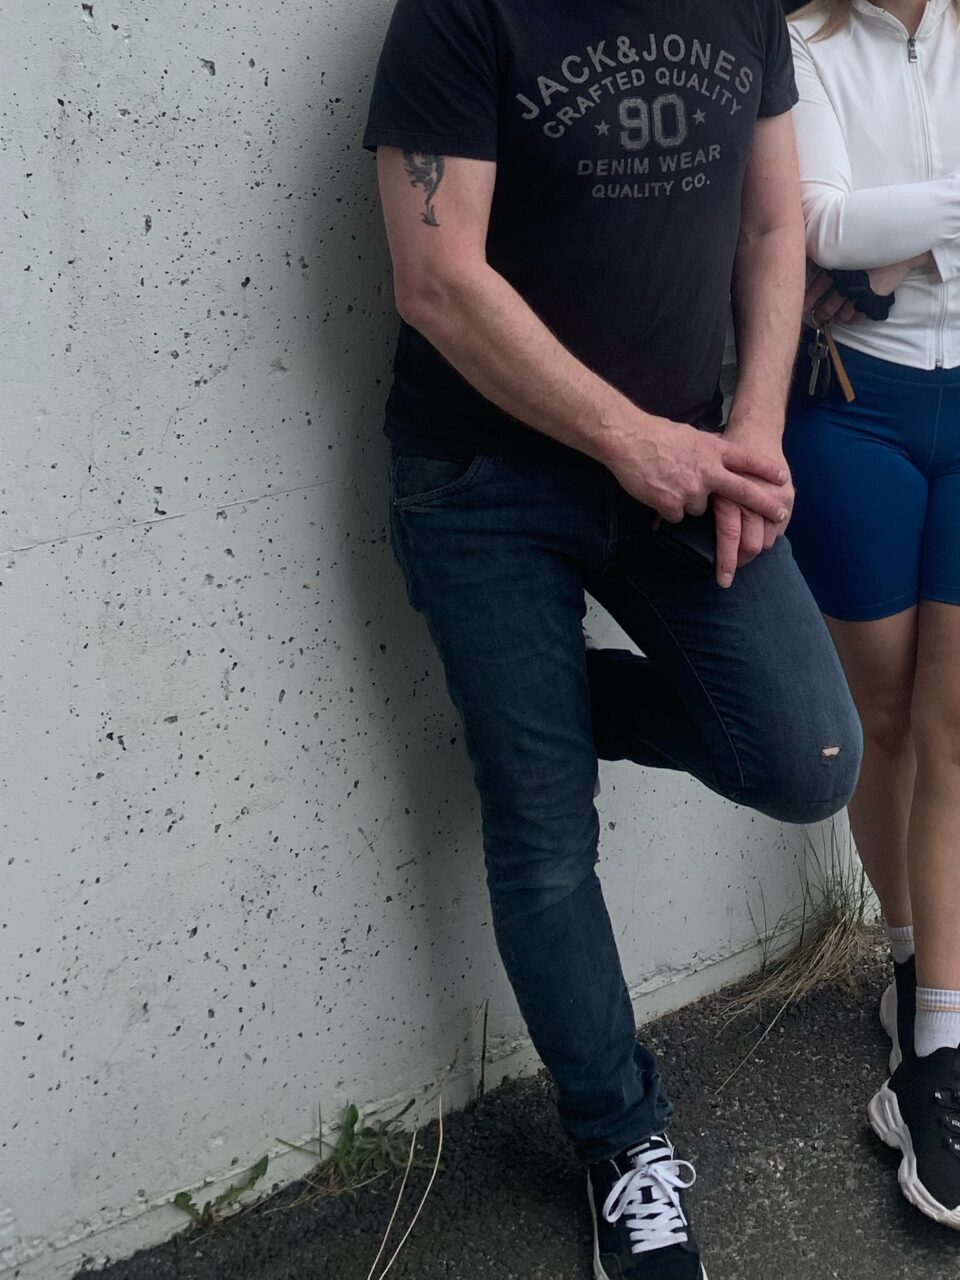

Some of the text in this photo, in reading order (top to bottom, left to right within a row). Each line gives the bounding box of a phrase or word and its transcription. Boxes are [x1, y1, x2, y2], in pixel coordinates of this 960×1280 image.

[515, 33, 753, 120] JACK&JONES
[542, 66, 742, 139] CRAFTED QUALITY
[618, 93, 687, 150] 90
[577, 144, 721, 176] DENIM WEAR
[592, 173, 711, 199] QUALITY CO.
